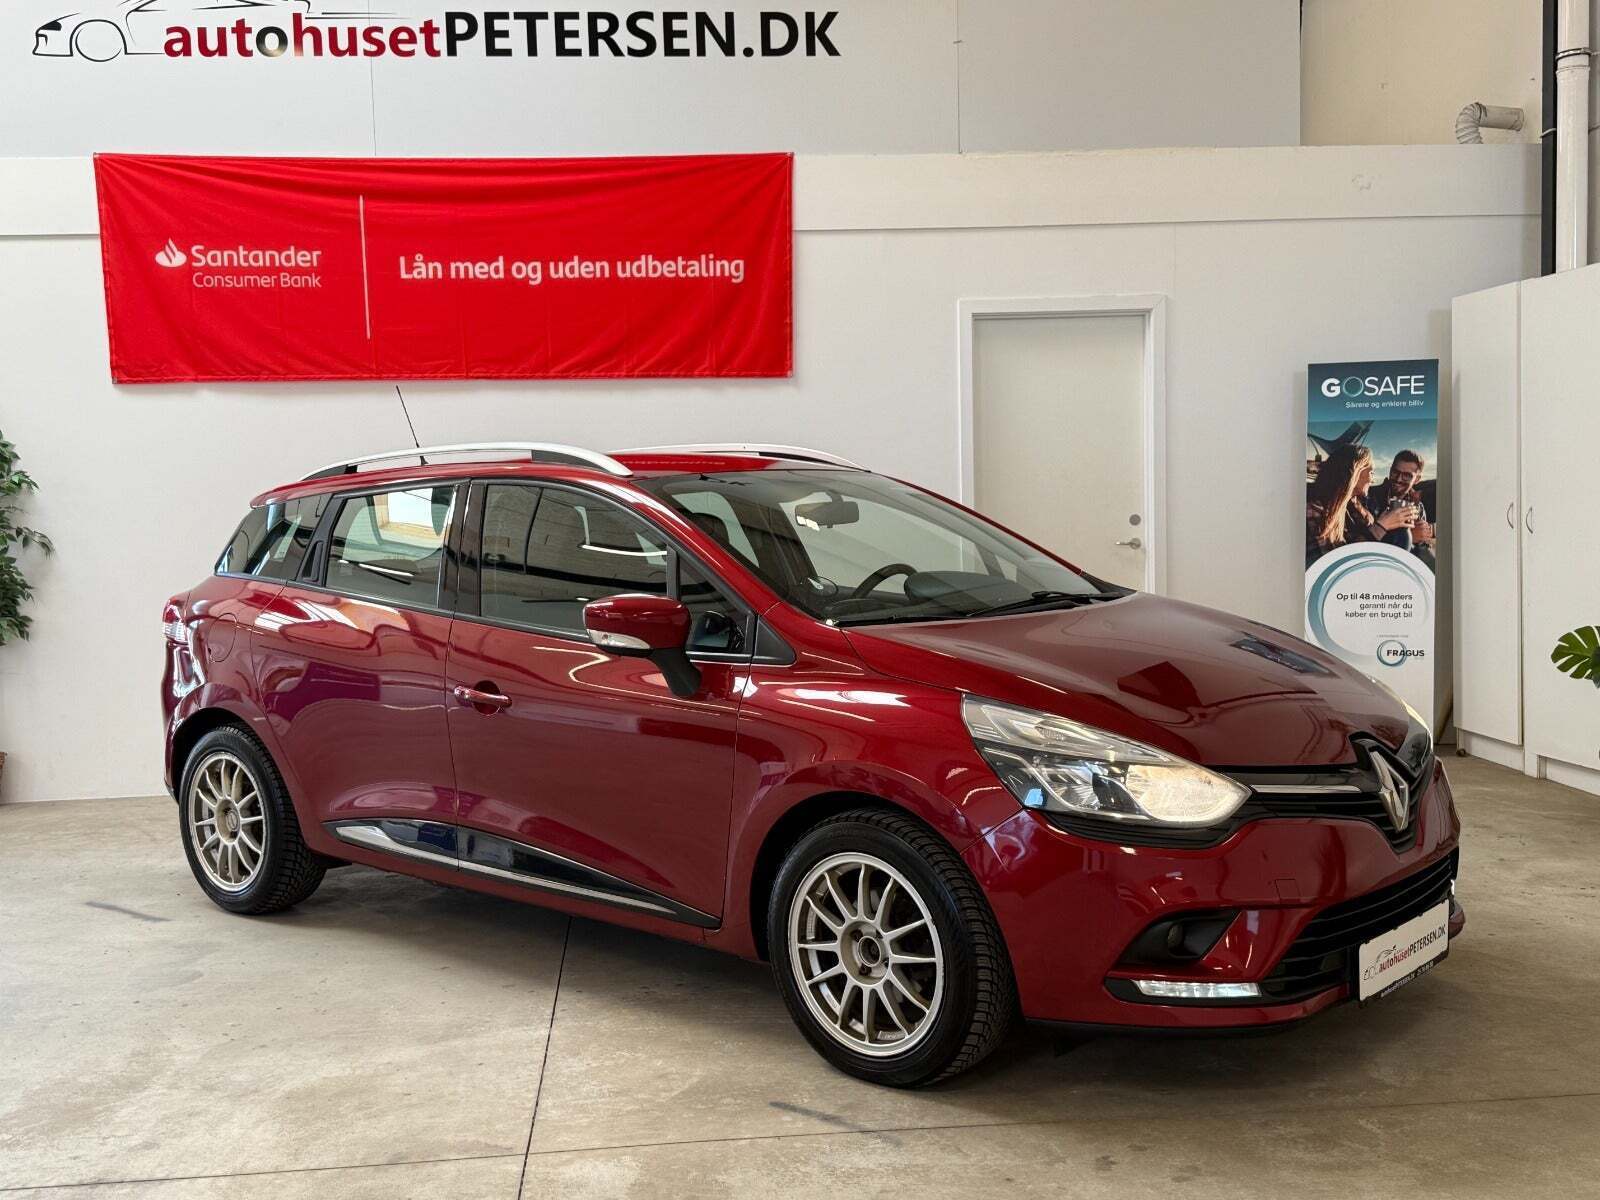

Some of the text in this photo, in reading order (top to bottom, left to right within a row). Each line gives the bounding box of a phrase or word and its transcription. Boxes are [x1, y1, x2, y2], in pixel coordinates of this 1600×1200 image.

[163, 10, 842, 59] autohusetPETERSEN.DK
[190, 245, 322, 268] Santander
[399, 253, 745, 286] Lån med og uden udbetaling
[192, 272, 322, 289] Consumer Bank
[1321, 375, 1425, 398] GOSAFE
[1336, 591, 1413, 602] Op til 48 måneders
[1359, 601, 1413, 611] garanti når du
[1345, 610, 1367, 618] køber
[1380, 610, 1402, 620] brugt
[1403, 610, 1413, 618] bil
[1386, 649, 1425, 657] FRAGUS
[1379, 924, 1446, 973] autohusetPETERSEN.DK
